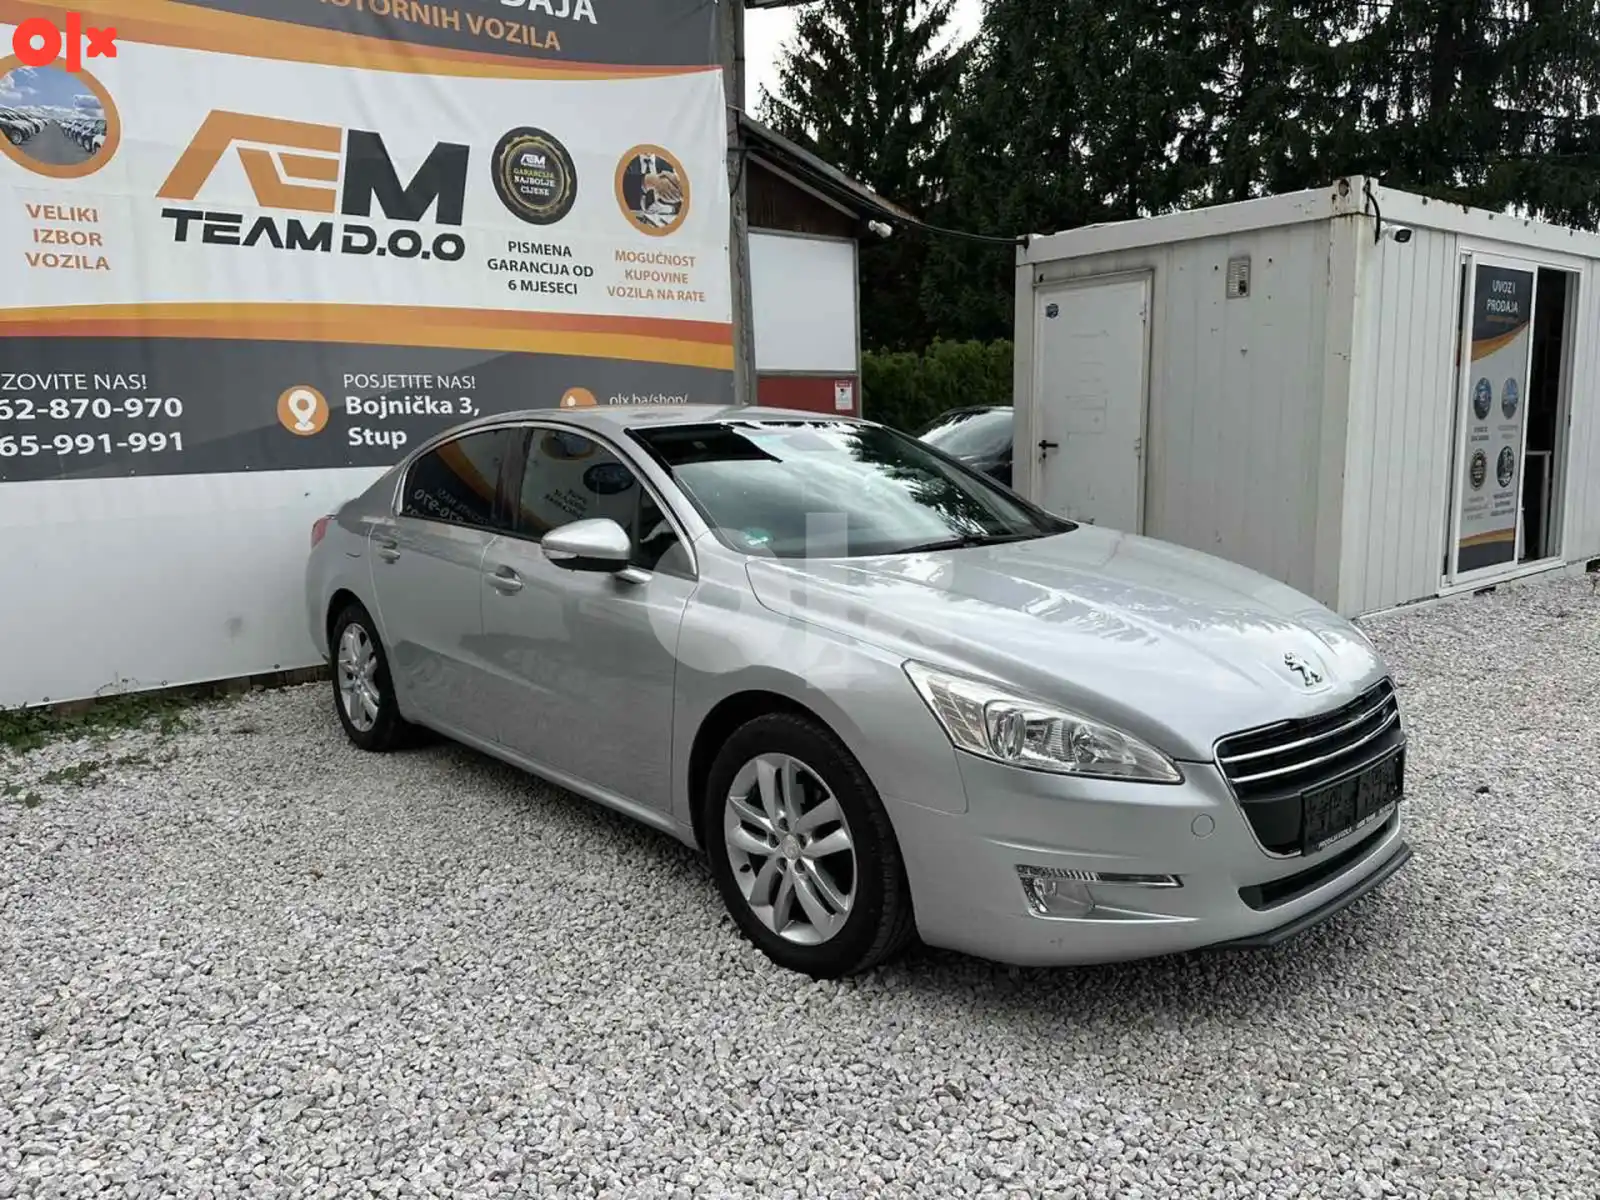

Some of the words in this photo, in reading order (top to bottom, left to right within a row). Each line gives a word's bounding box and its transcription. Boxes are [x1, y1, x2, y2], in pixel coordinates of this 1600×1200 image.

[465, 13, 561, 51] VOZILA
[25, 204, 99, 223] VELIKI
[33, 228, 103, 247] IZBOR
[161, 208, 333, 252] TEAM
[508, 240, 572, 258] PISMENA
[615, 249, 696, 267] MOGUĆNOST
[25, 252, 111, 271] VOZILA
[487, 258, 569, 276] GARANCIJA
[573, 265, 594, 278] OD
[624, 269, 689, 284] KUPOVINE
[508, 279, 517, 291] 6
[520, 280, 578, 295] MJESECI
[607, 286, 654, 300] VOZILA
[656, 289, 675, 301] NA
[677, 291, 706, 302] RATE
[1486, 298, 1519, 313] PRODAJA
[1, 373, 88, 390] ZOVITE
[94, 374, 147, 390] NAS!
[343, 374, 432, 389] POSJETITE
[437, 375, 477, 389] NAS!
[345, 395, 453, 420] Bojnička
[459, 396, 480, 417] 3,
[348, 426, 407, 450] Stup
